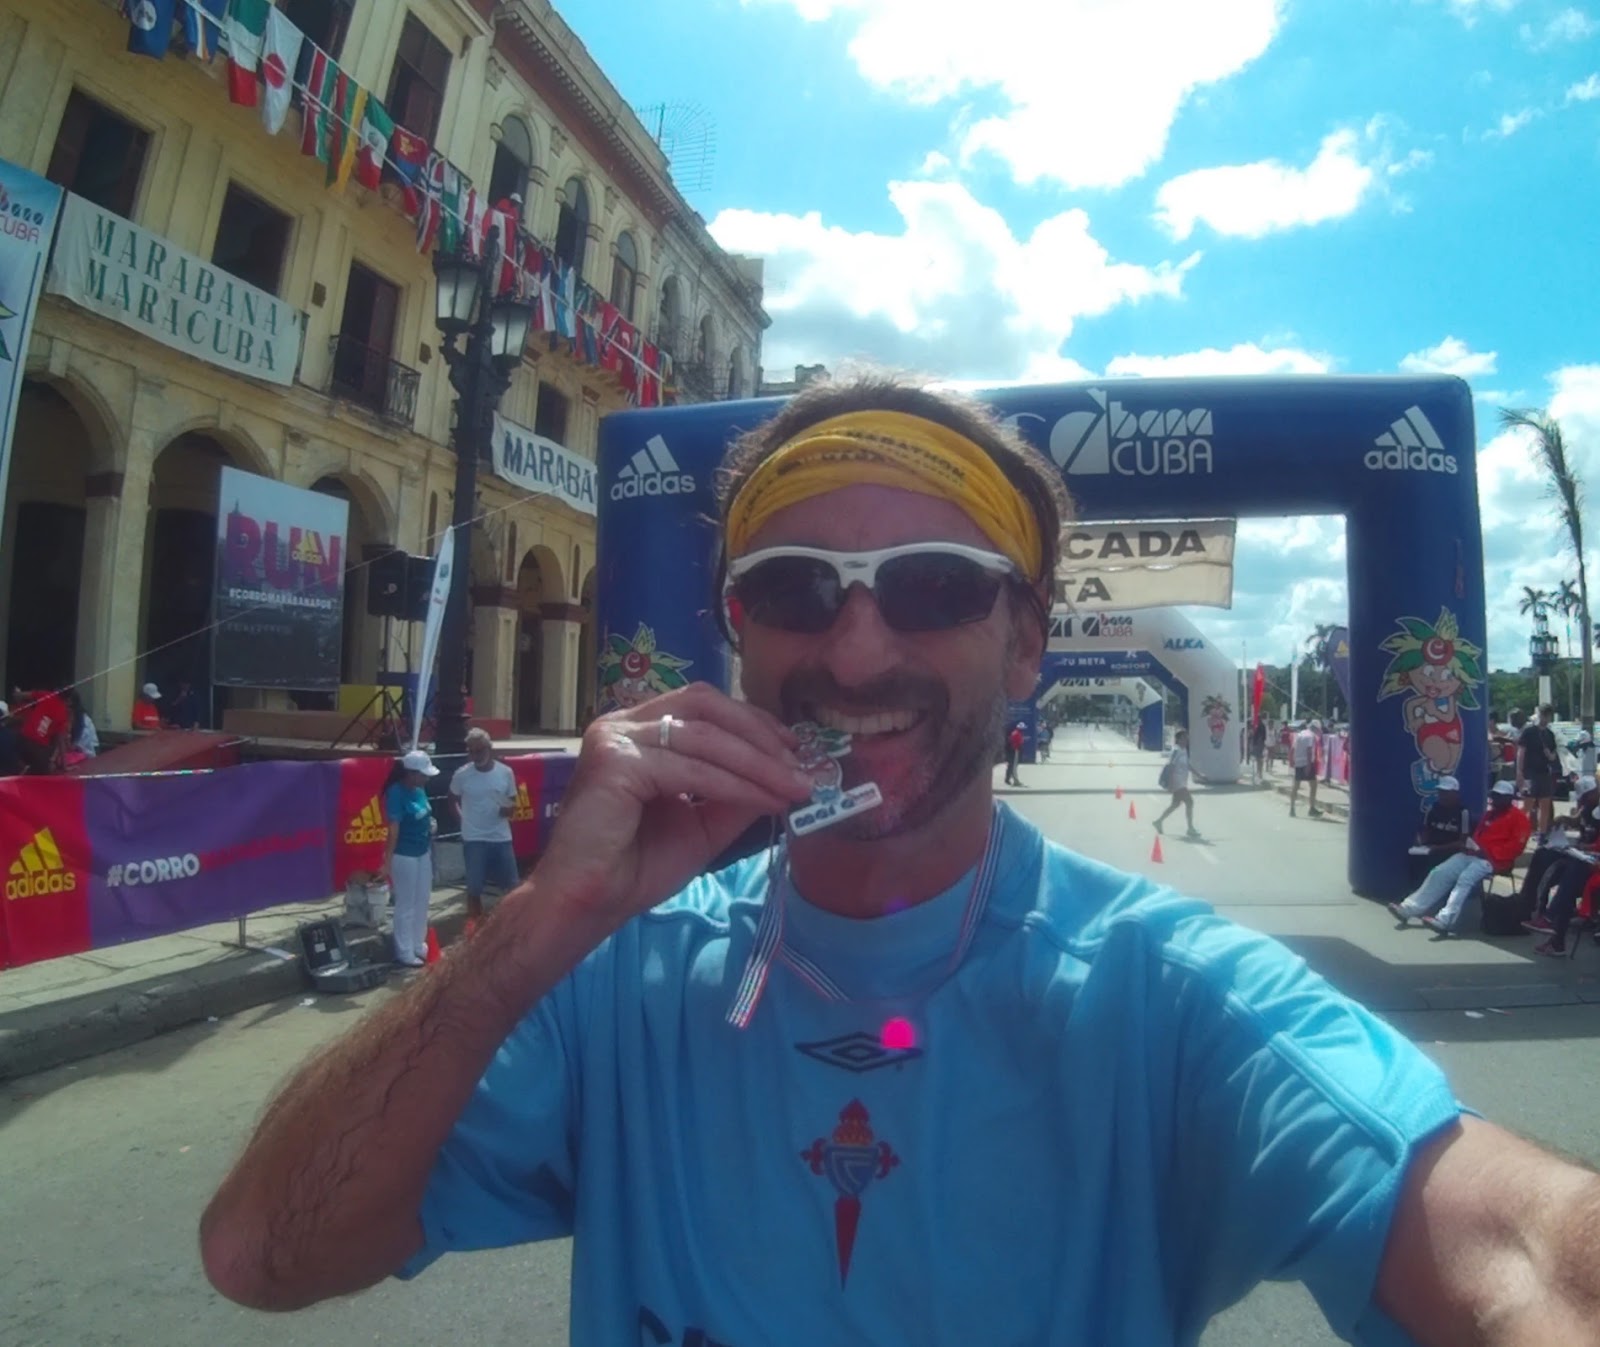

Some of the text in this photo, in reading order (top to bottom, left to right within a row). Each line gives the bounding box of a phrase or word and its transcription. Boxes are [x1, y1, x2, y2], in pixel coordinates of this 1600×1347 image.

[96, 213, 279, 336] MARABANA
[84, 258, 276, 372] MARACUBA
[503, 431, 594, 503] MARABA
[1111, 438, 1214, 476] CUBA
[1363, 446, 1458, 475] adidas
[610, 472, 696, 500] adidas
[225, 512, 341, 594] RUN
[1163, 638, 1204, 650] ALKA
[344, 823, 389, 844] adidas
[6, 869, 76, 900] adidas
[107, 852, 200, 888] #CORRO
